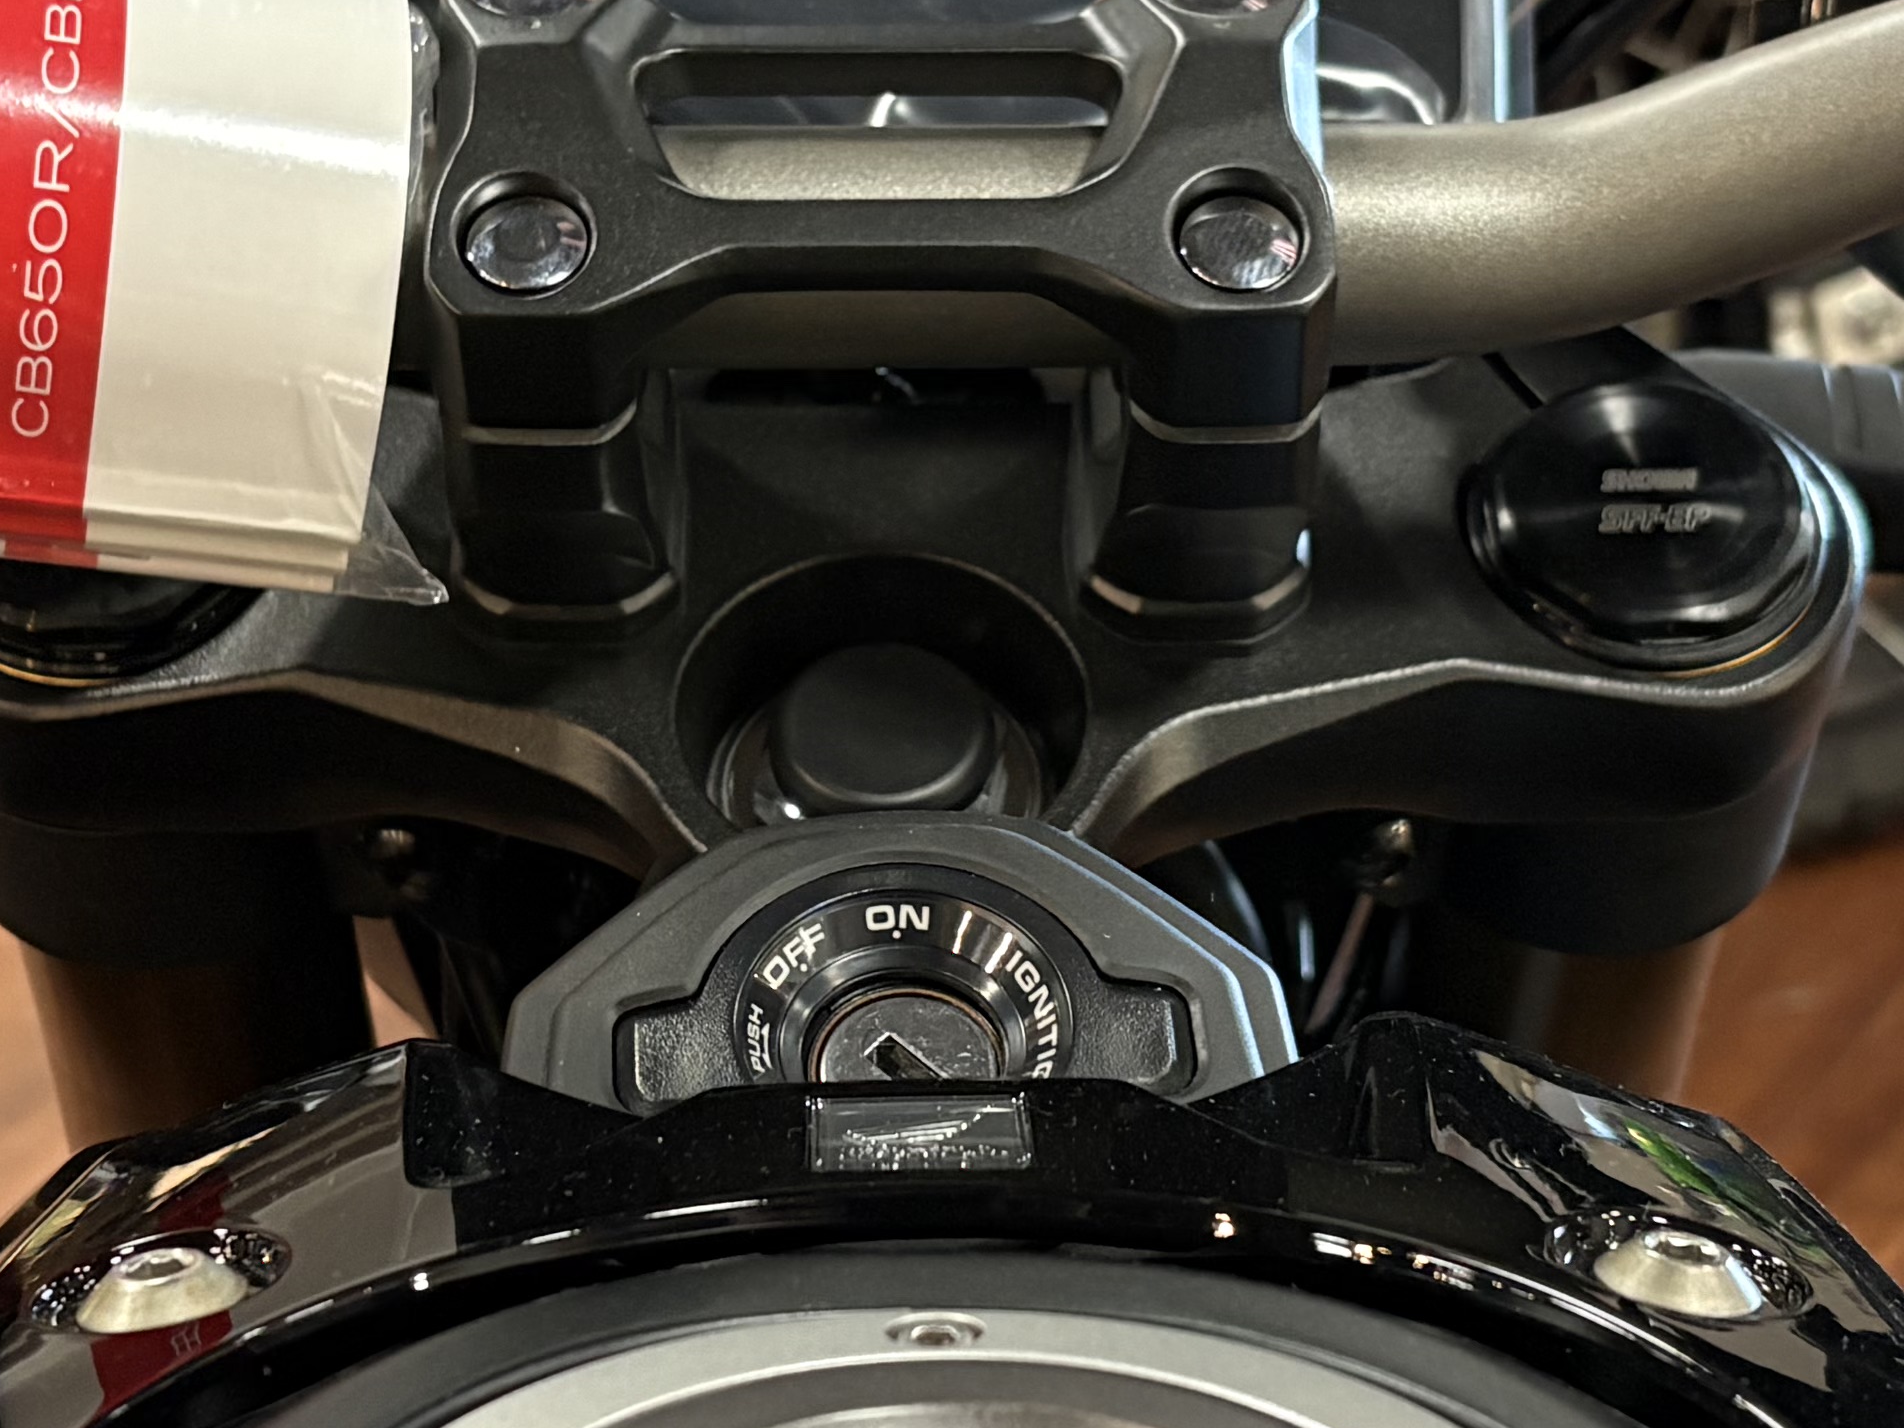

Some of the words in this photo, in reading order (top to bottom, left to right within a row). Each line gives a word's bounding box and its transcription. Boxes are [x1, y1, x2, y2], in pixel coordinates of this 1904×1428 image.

[865, 904, 930, 931] ON
[762, 922, 825, 990] OFF
[746, 1003, 766, 1073] PUSH
